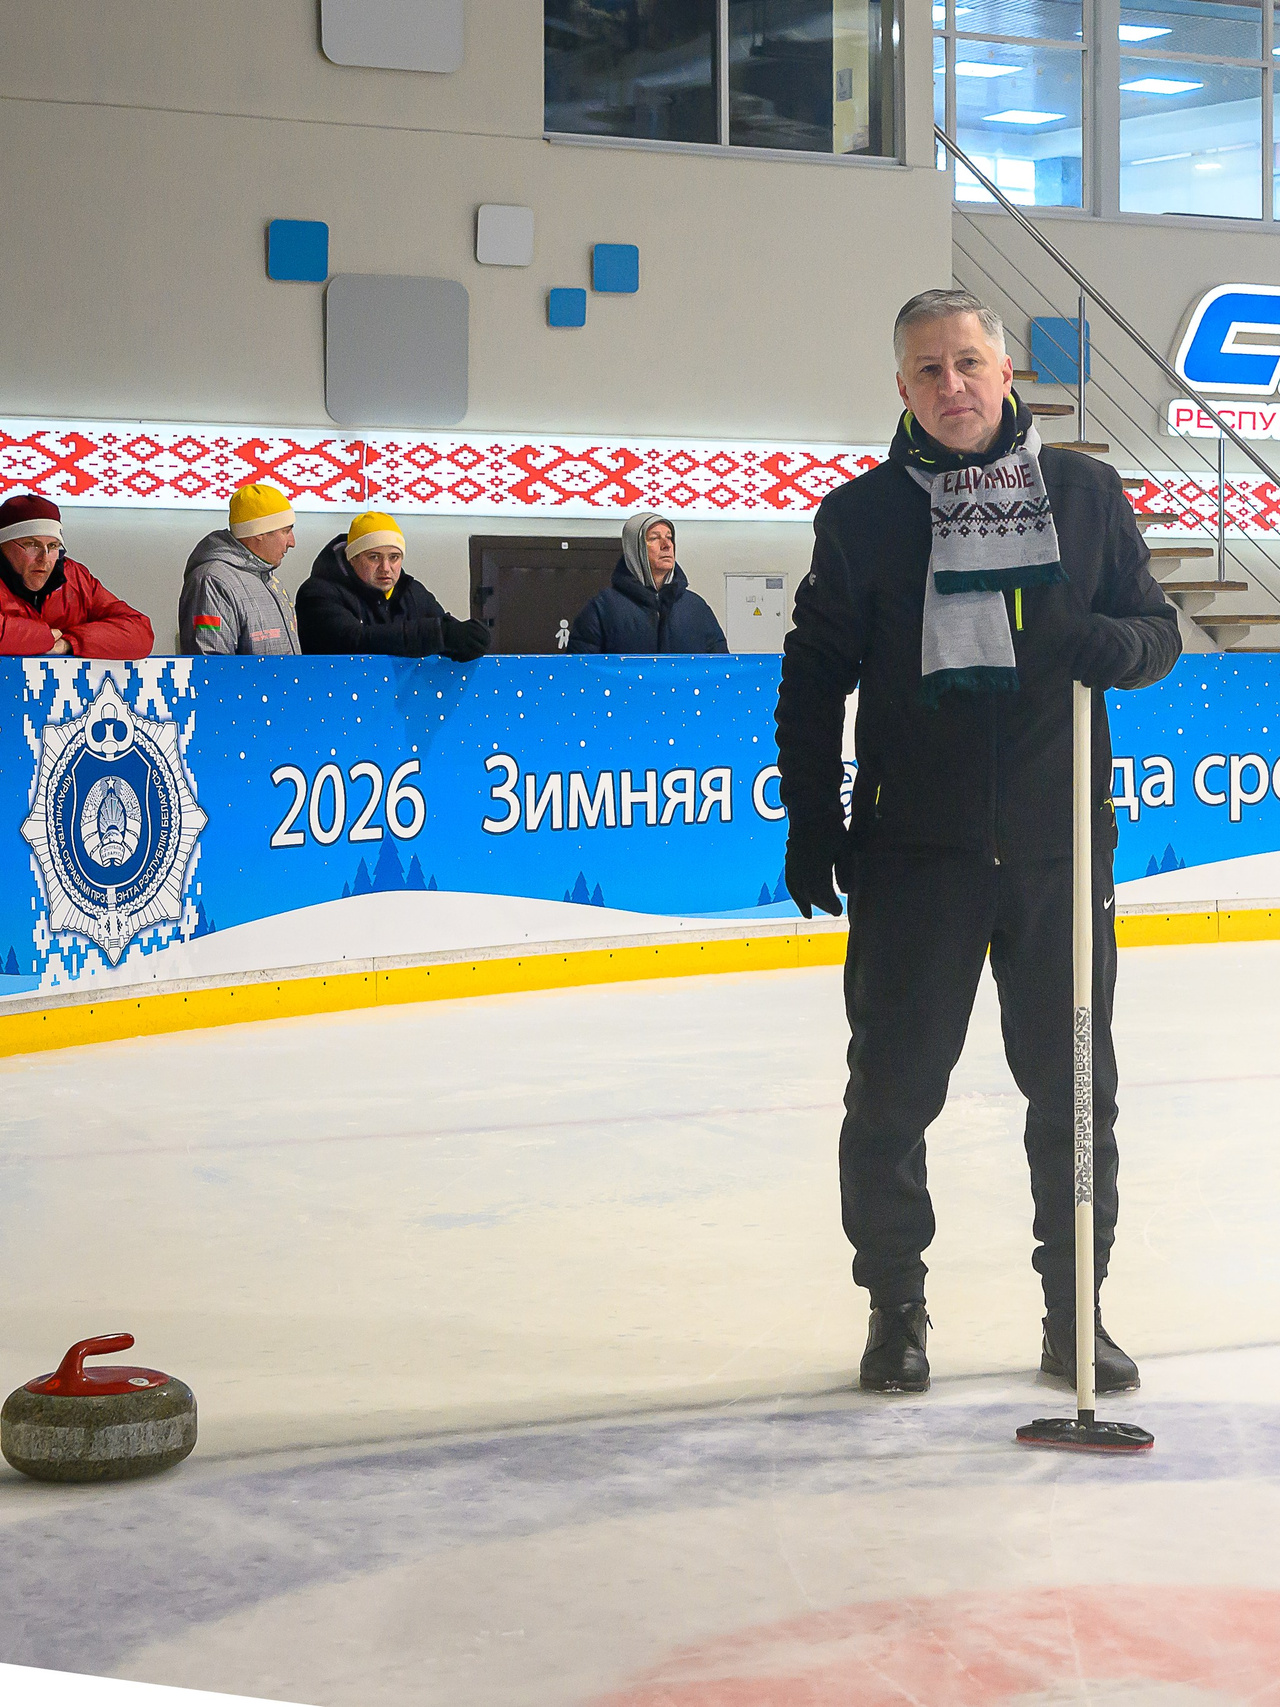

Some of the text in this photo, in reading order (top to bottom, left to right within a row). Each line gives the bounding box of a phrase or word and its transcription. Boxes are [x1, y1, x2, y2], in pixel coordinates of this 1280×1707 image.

[943, 463, 1035, 495] ЕДИНЫЕ
[269, 758, 427, 848] 2026
[481, 753, 734, 835] Зимняя
[90, 886, 140, 904] ПРЭЭНТА
